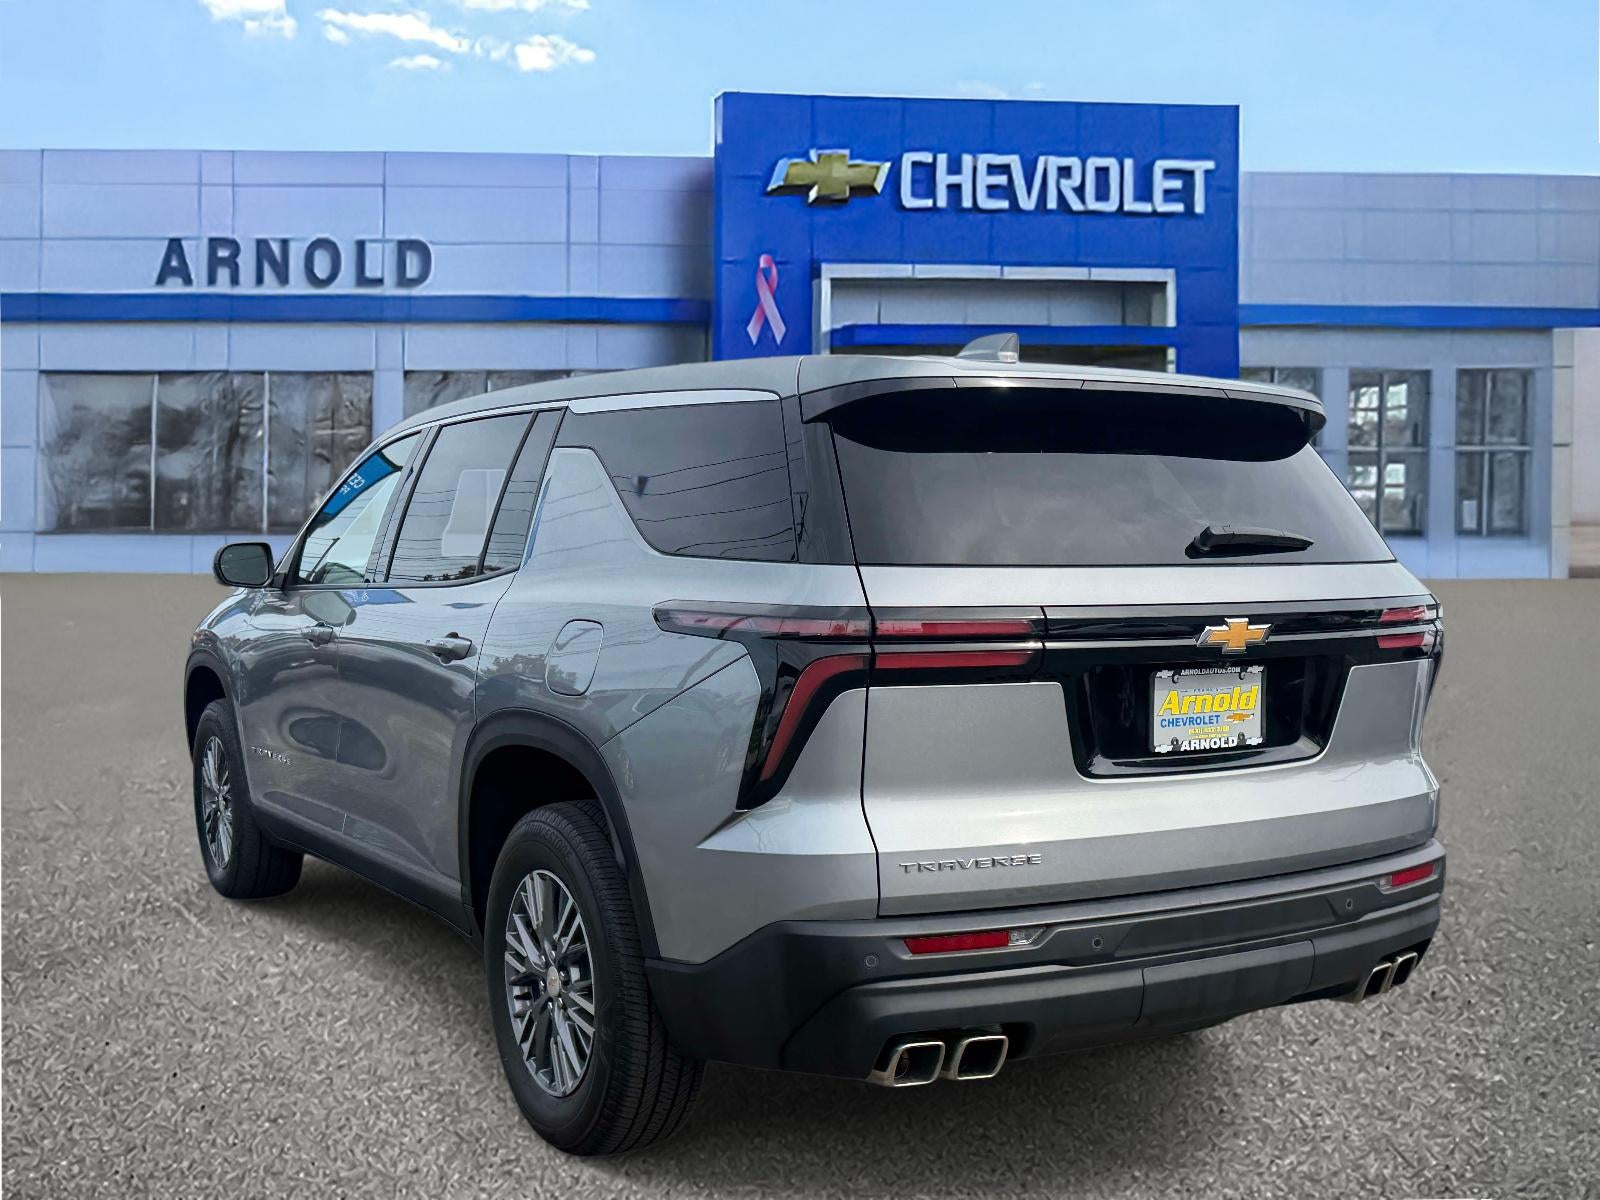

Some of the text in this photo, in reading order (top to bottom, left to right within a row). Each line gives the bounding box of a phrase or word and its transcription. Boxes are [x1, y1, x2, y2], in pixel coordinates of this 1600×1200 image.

[901, 152, 1215, 214] CHEVROLET
[155, 237, 432, 288] ARNOLD
[1157, 685, 1259, 716] Arnold
[1160, 715, 1220, 728] CHEVROLET
[1181, 736, 1238, 752] ARNOLD
[899, 853, 1042, 874] TRAVERSE
